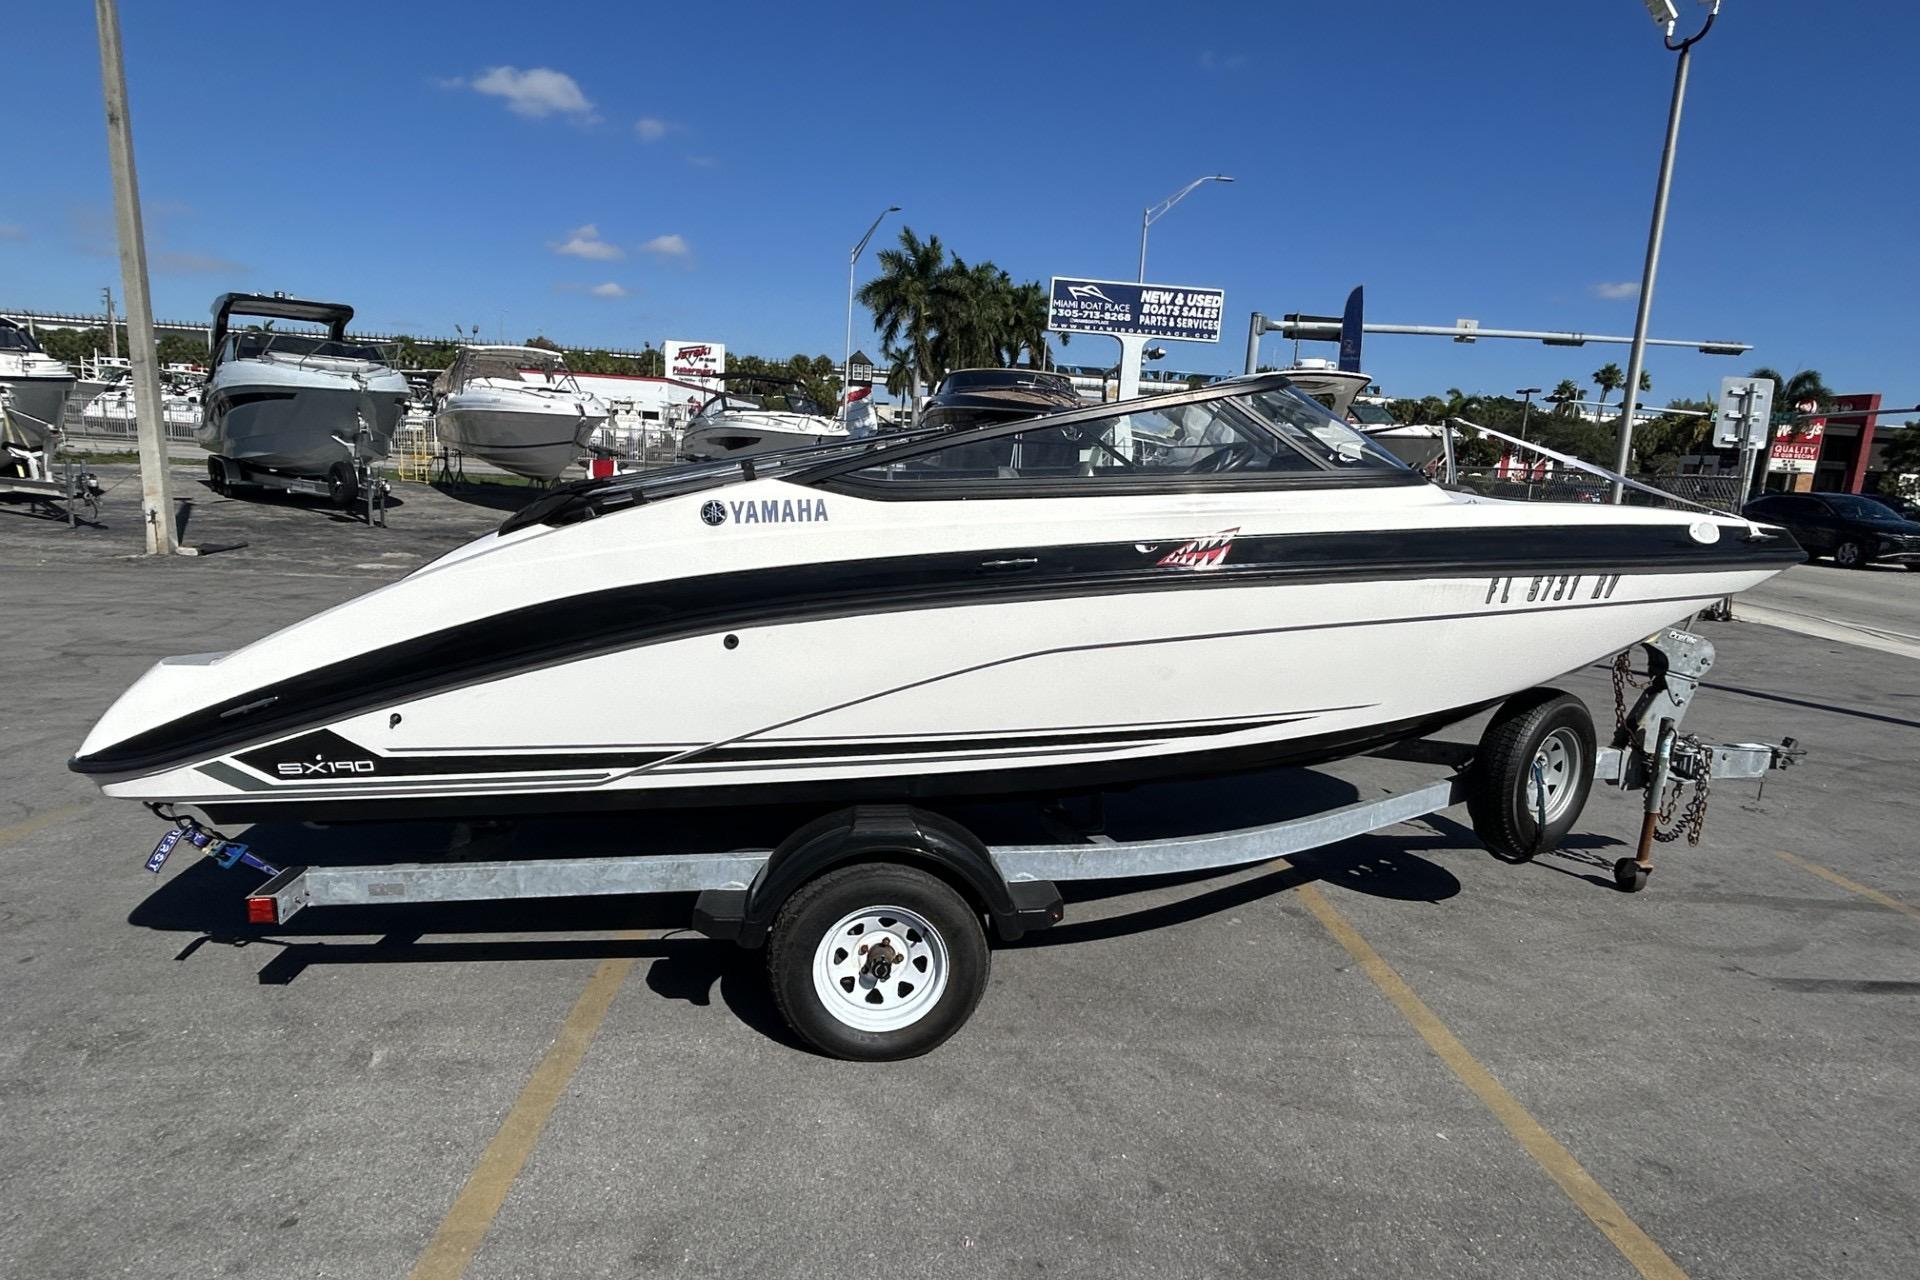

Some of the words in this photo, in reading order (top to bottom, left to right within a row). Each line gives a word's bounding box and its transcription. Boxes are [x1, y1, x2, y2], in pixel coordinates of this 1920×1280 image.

[1053, 299, 1078, 309] MIAMI
[1081, 301, 1102, 311] BOAT
[1105, 303, 1130, 313] PLACE
[1141, 290, 1174, 304] NEW
[1175, 292, 1184, 305] &
[1187, 293, 1221, 308] USED
[1058, 309, 1131, 322] 305-713-8268
[1142, 304, 1180, 316] BOATS
[1182, 306, 1218, 319] SALES
[1139, 316, 1166, 327] PARTS
[1169, 318, 1175, 328] &
[1176, 318, 1219, 331] SERVICES
[1774, 445, 1816, 454] QUALITY
[730, 499, 828, 524] YAMAHA
[1527, 575, 1581, 602] 5731
[277, 760, 375, 775] SX190
